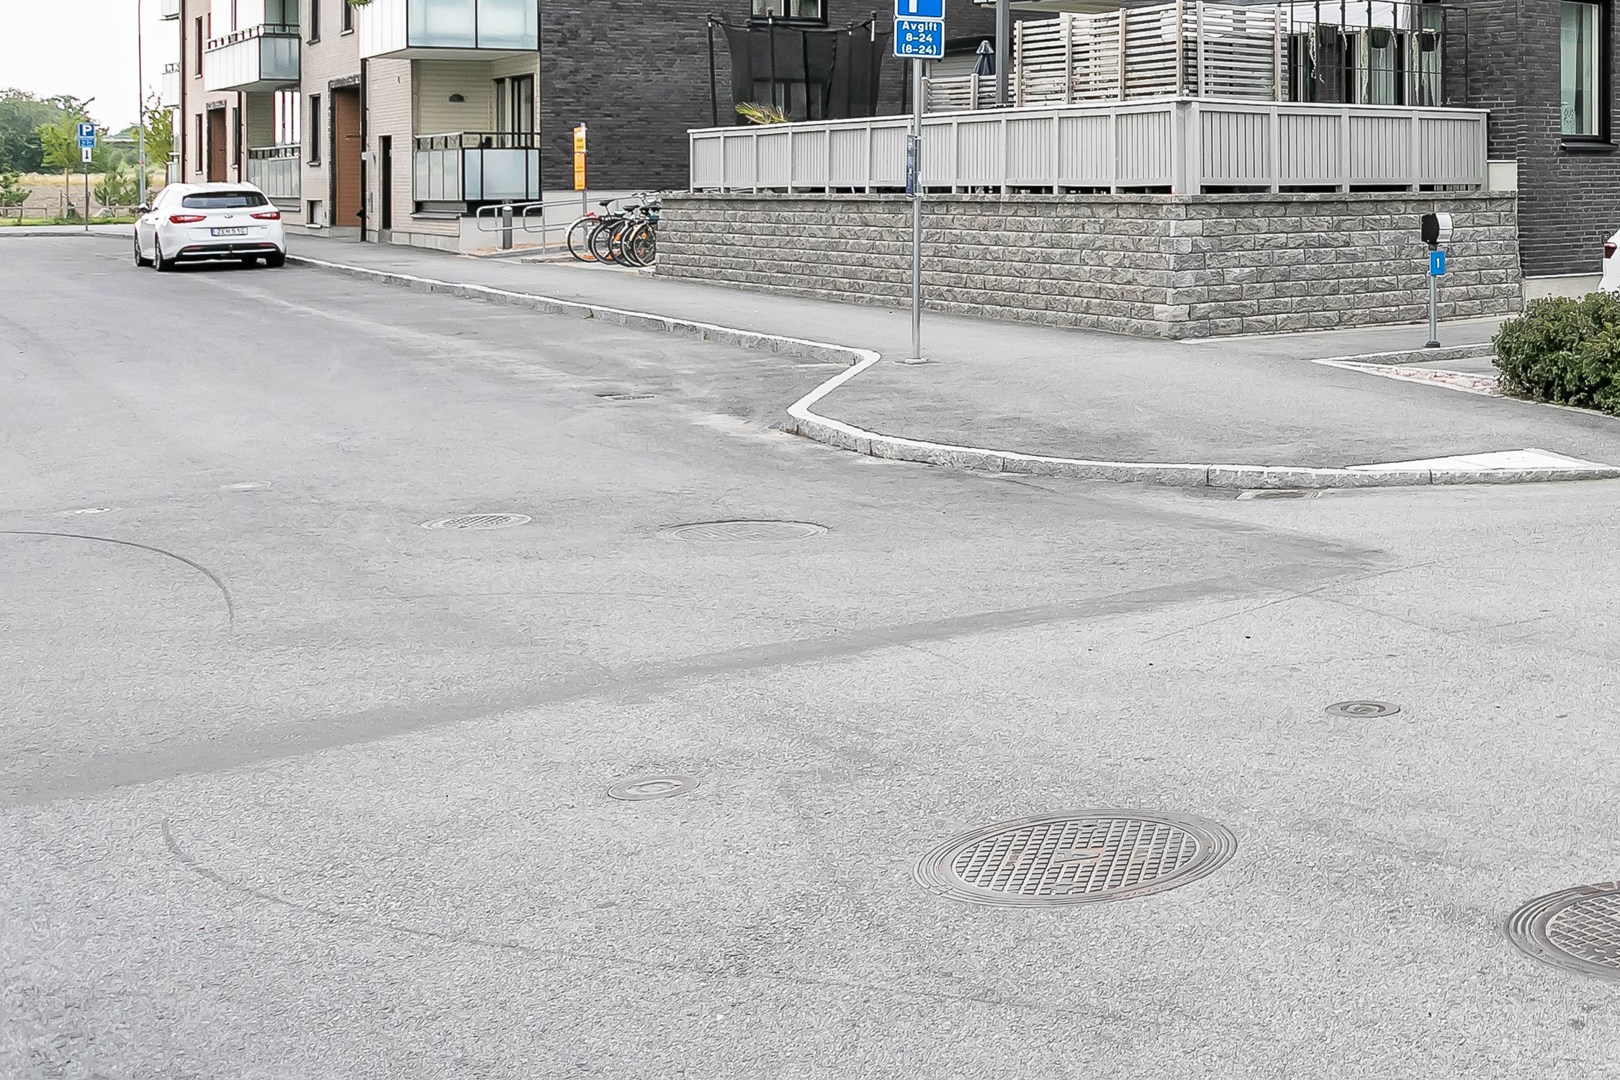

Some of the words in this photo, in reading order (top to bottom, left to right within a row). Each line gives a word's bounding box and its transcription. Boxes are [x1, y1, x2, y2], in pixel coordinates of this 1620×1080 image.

[902, 21, 937, 33] Avgift
[905, 32, 933, 43] 8-24
[901, 43, 937, 55] (8-24)
[82, 124, 93, 136] P
[1436, 257, 1440, 269] 1
